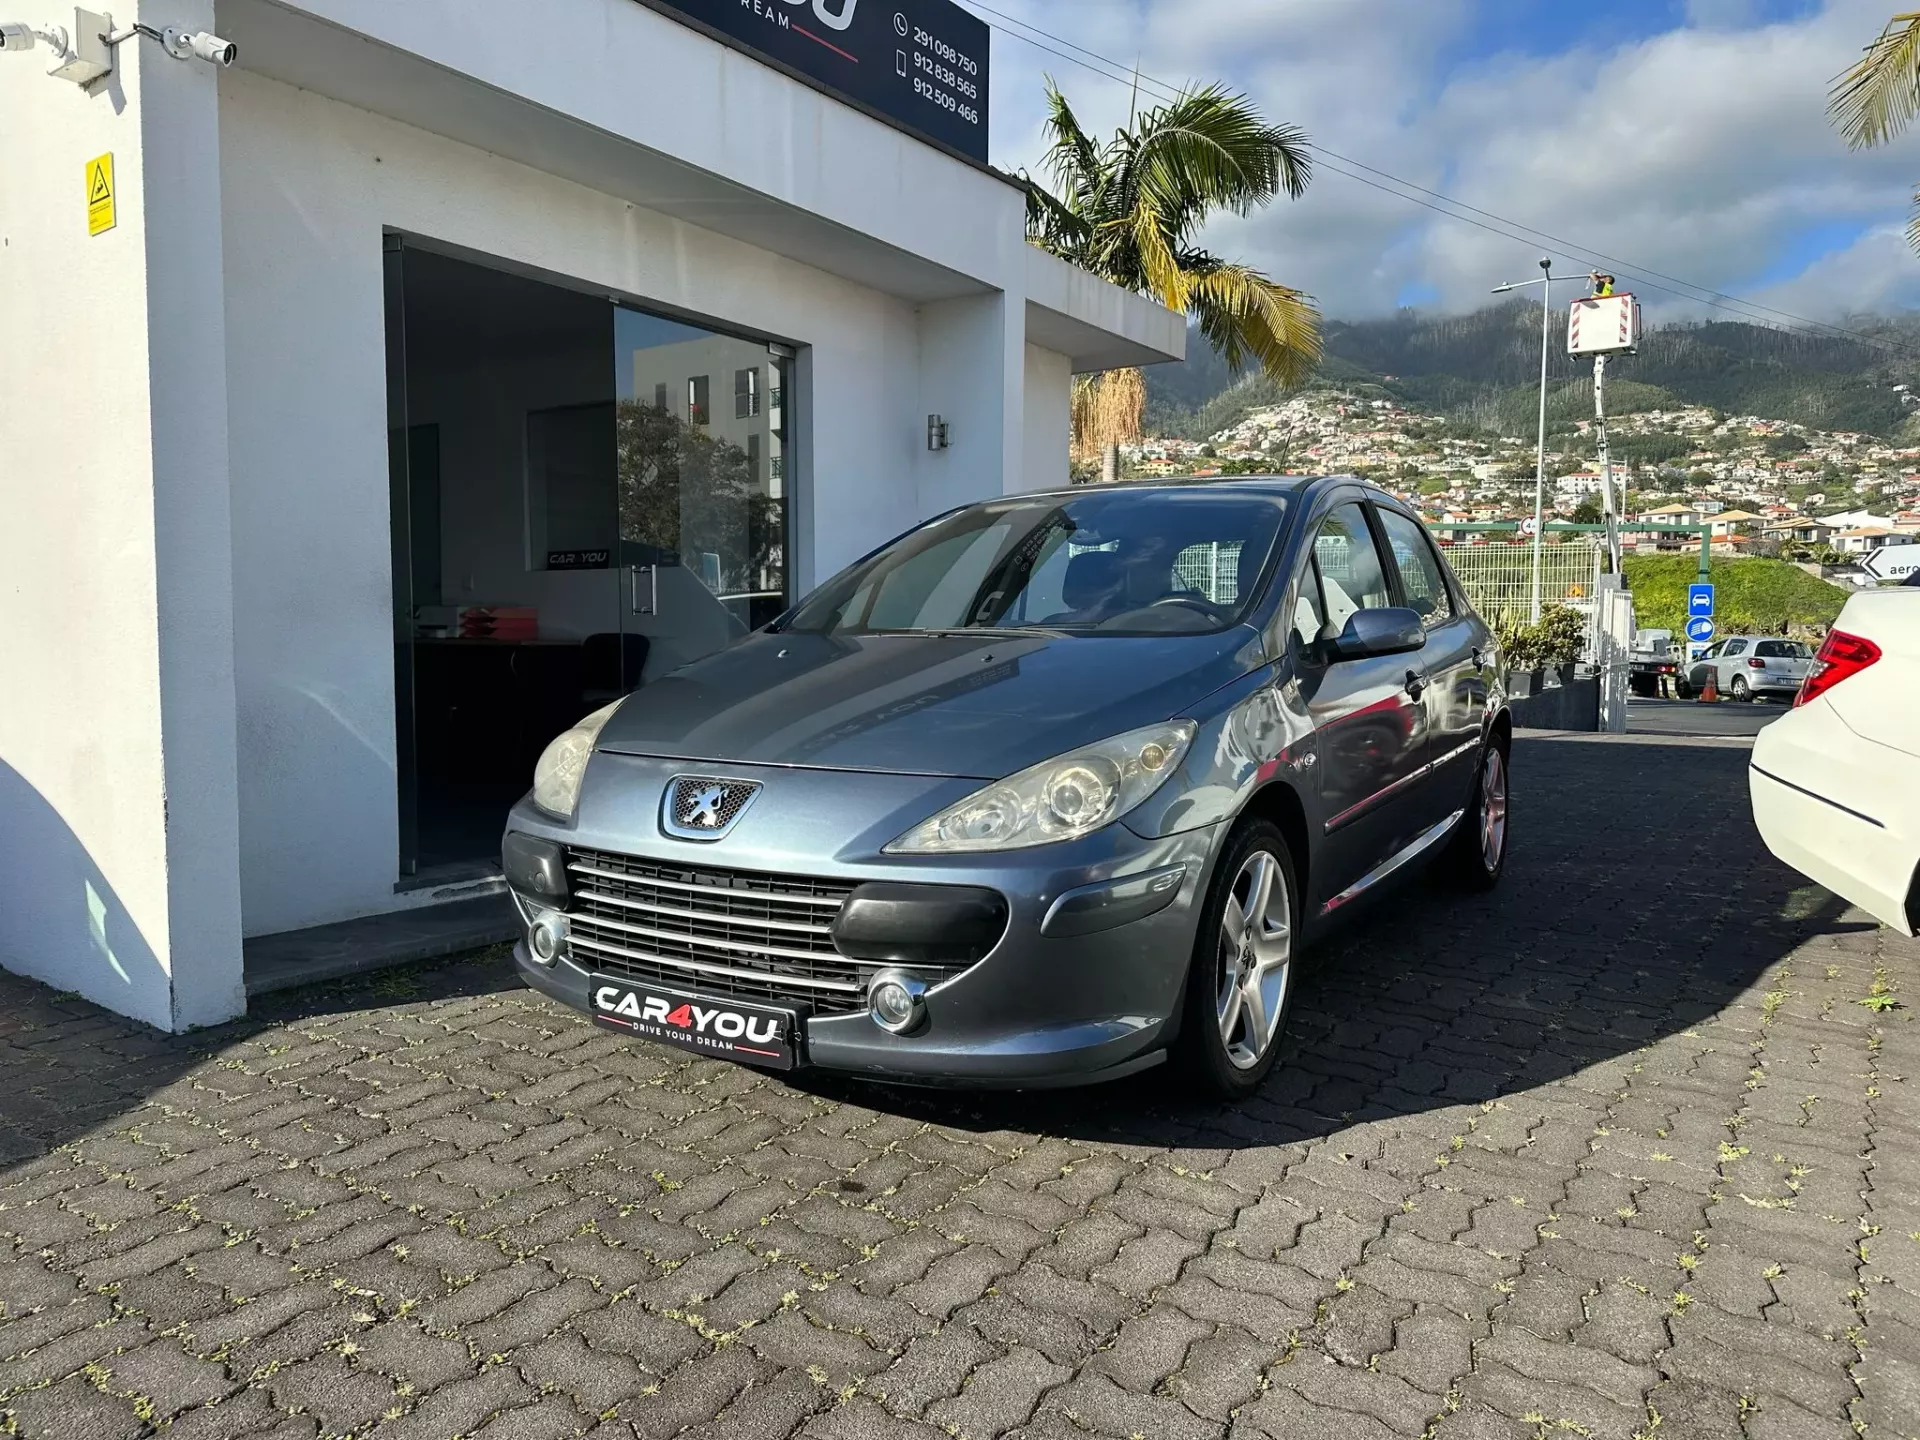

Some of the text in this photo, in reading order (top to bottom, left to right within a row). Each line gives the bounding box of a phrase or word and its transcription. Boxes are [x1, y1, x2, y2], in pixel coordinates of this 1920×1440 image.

[913, 26, 977, 76] 291 098 750
[913, 51, 977, 99] 912 838 565
[913, 77, 978, 124] 912 509 466
[595, 986, 778, 1043] CAR4YOU
[633, 1022, 733, 1051] DRIVE YOUR DREAM
